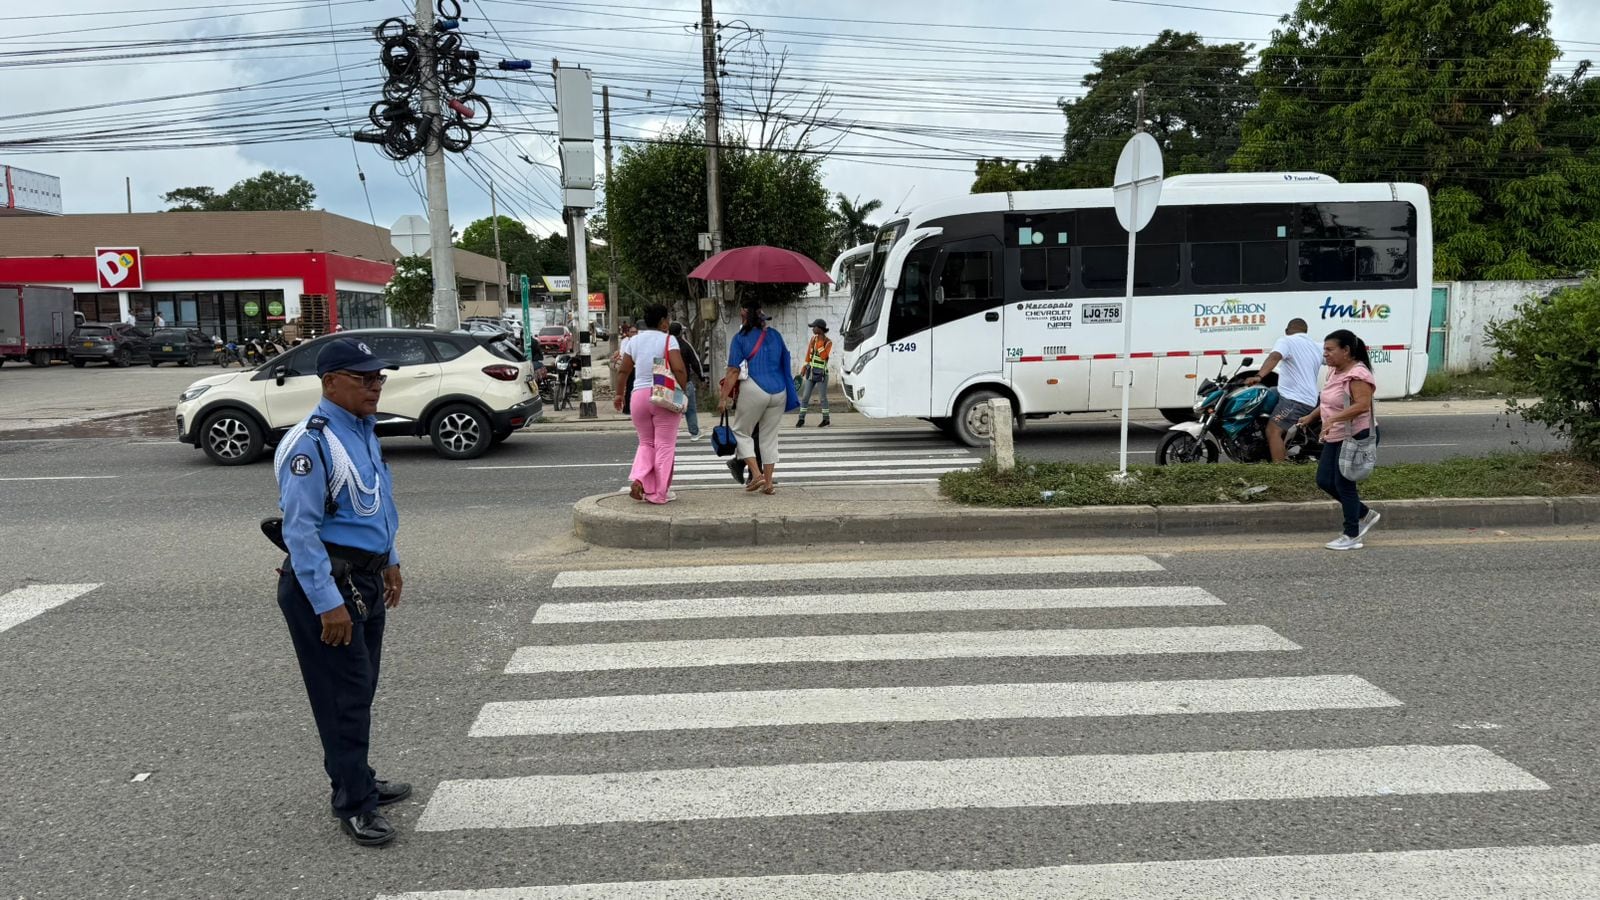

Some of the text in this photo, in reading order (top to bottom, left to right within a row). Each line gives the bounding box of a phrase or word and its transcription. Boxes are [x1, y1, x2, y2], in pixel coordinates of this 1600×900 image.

[98, 252, 134, 287] D1
[1025, 302, 1073, 310] Marcopolo
[1194, 303, 1266, 316] DECAMERON
[890, 343, 917, 352] T-249
[1007, 348, 1023, 356] T-249
